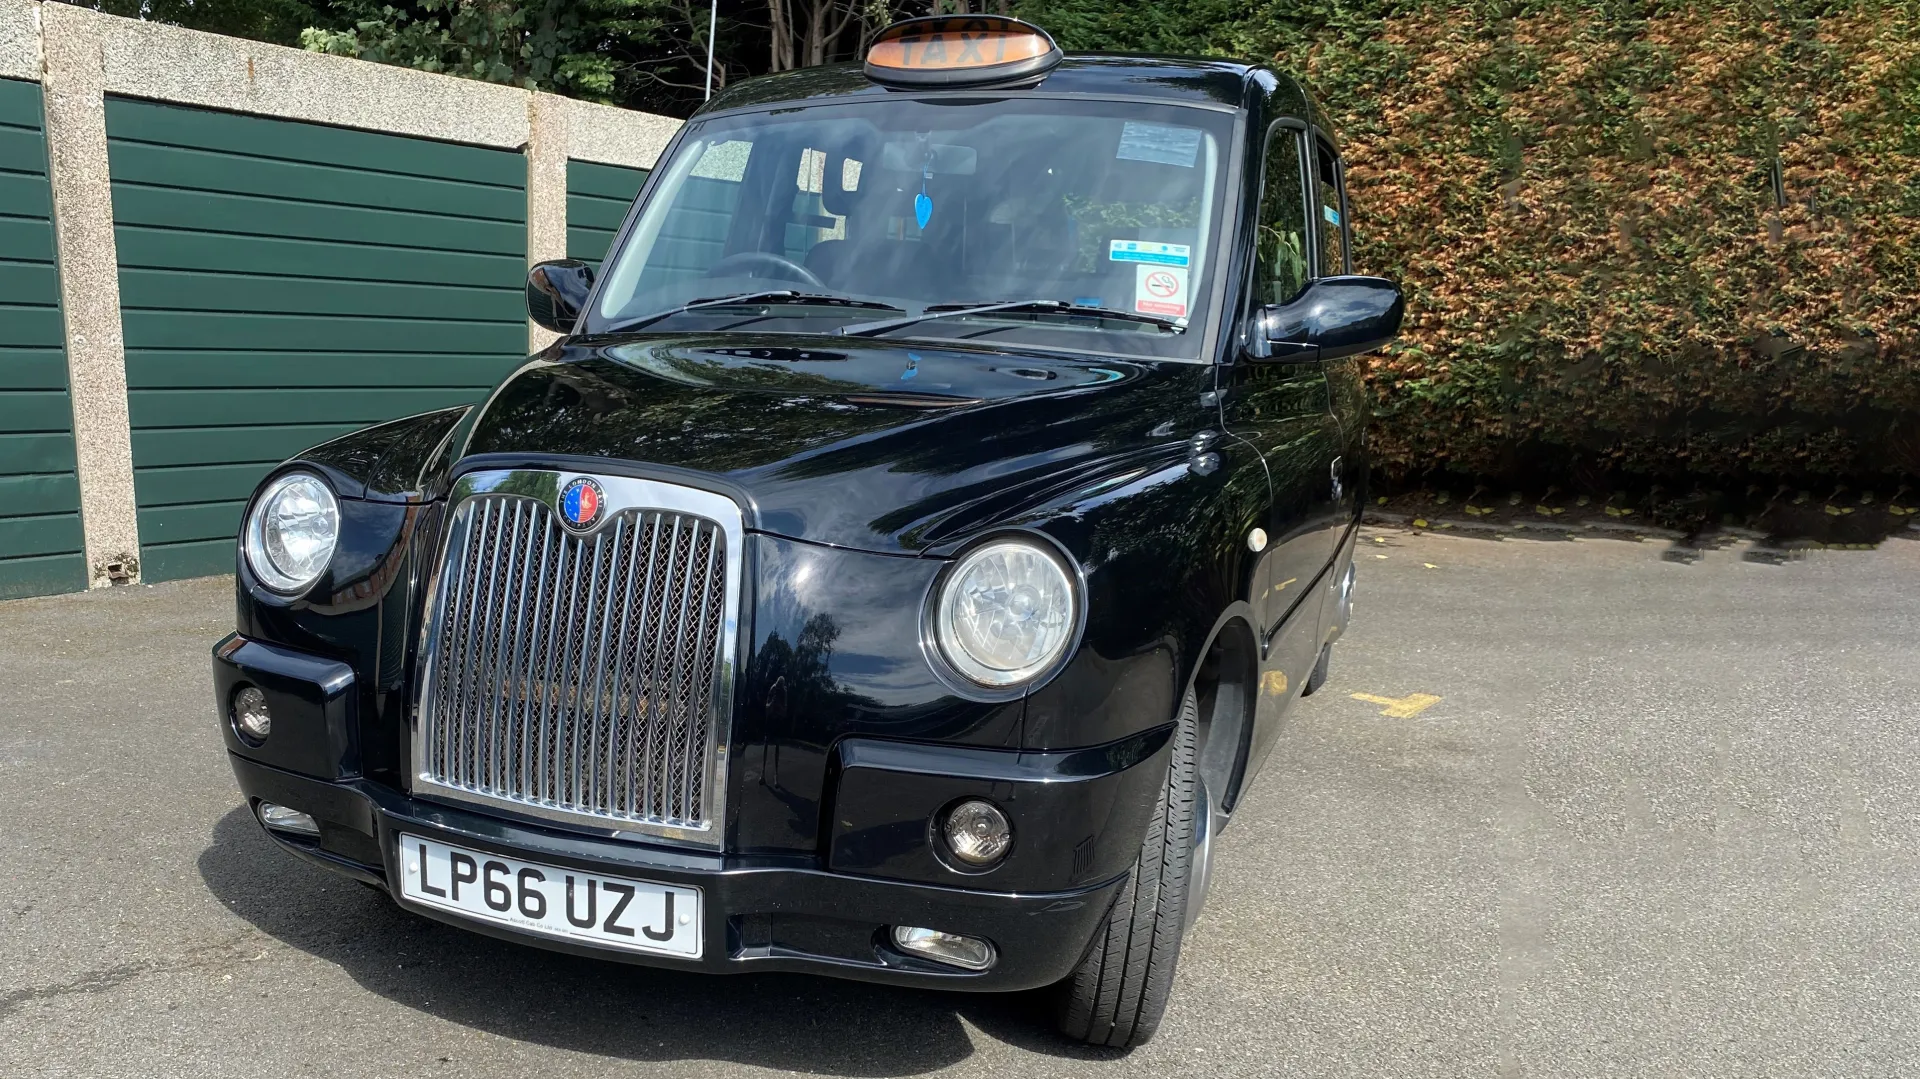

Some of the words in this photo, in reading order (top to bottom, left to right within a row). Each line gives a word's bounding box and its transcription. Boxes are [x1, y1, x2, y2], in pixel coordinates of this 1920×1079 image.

[899, 33, 1009, 65] TAXI
[568, 479, 597, 489] LONDON
[596, 489, 604, 507] TAXI
[418, 843, 547, 920] LP66
[565, 874, 675, 942] UZJ
